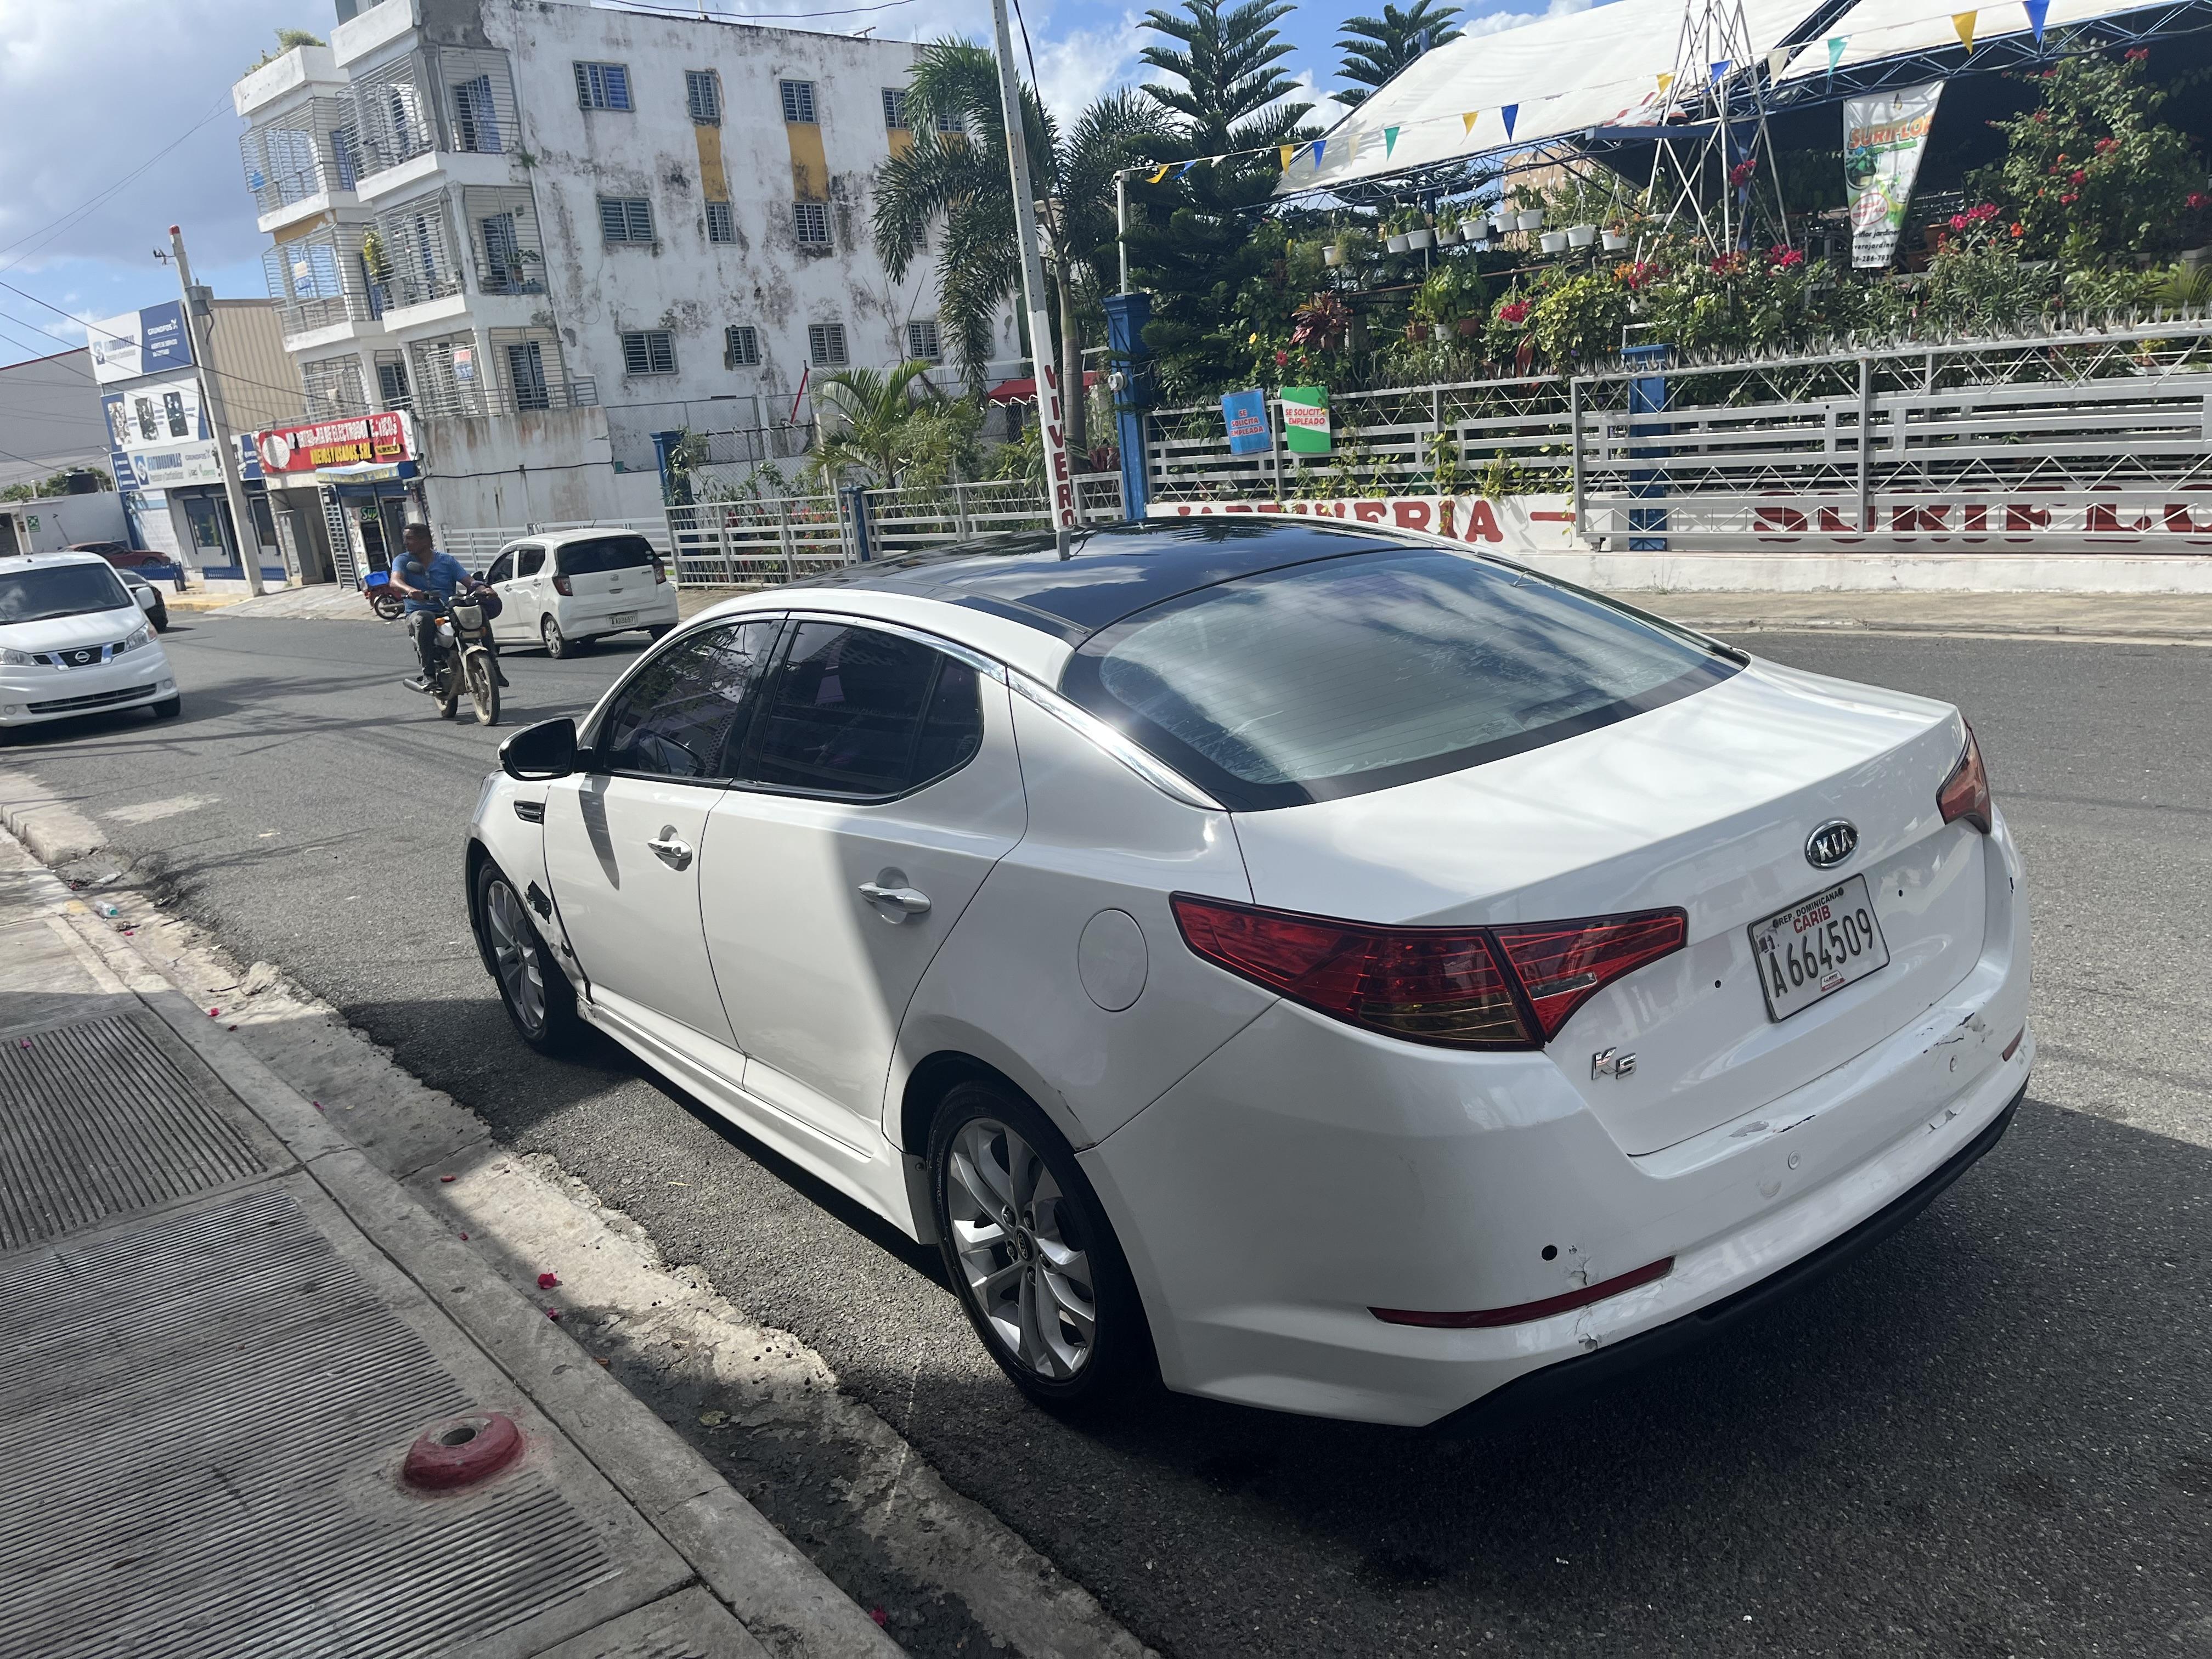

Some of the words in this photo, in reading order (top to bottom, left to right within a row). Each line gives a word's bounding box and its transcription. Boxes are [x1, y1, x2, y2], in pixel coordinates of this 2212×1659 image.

[1231, 417, 1259, 427] SOLICITA
[1239, 409, 1248, 417] SE
[1288, 417, 1326, 426] EMPLEADO
[1231, 426, 1264, 437] EMPLEADA
[1816, 827, 1854, 861] KIA
[1779, 913, 1796, 926] REP.
[1796, 891, 1839, 917] DOMINICANA
[1793, 905, 1831, 934] CARIB
[1769, 909, 1873, 997] A664509
